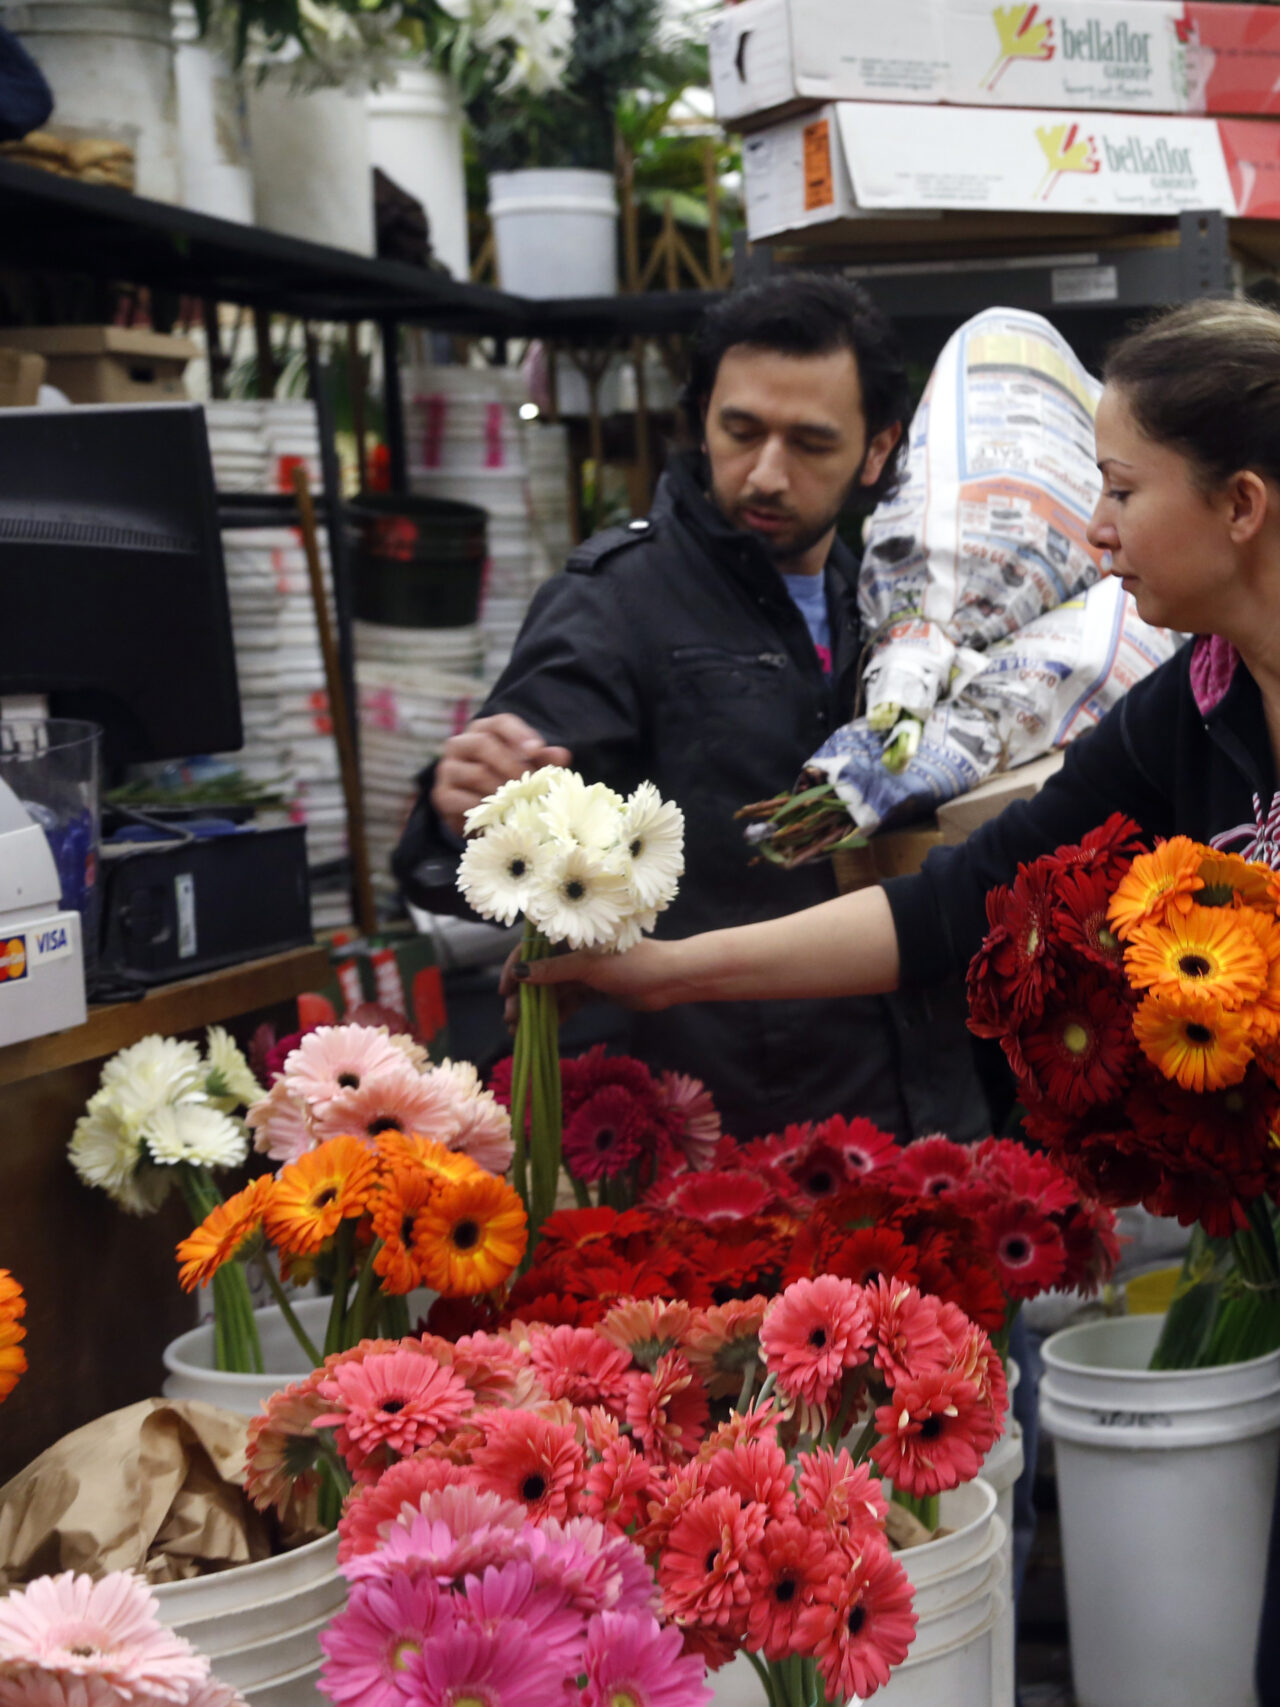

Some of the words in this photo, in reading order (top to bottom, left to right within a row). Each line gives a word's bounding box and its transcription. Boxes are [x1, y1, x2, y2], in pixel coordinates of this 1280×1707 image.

[1060, 17, 1153, 64] bellaflor
[1102, 134, 1194, 175] bellaflor
[35, 927, 68, 954] VISA
